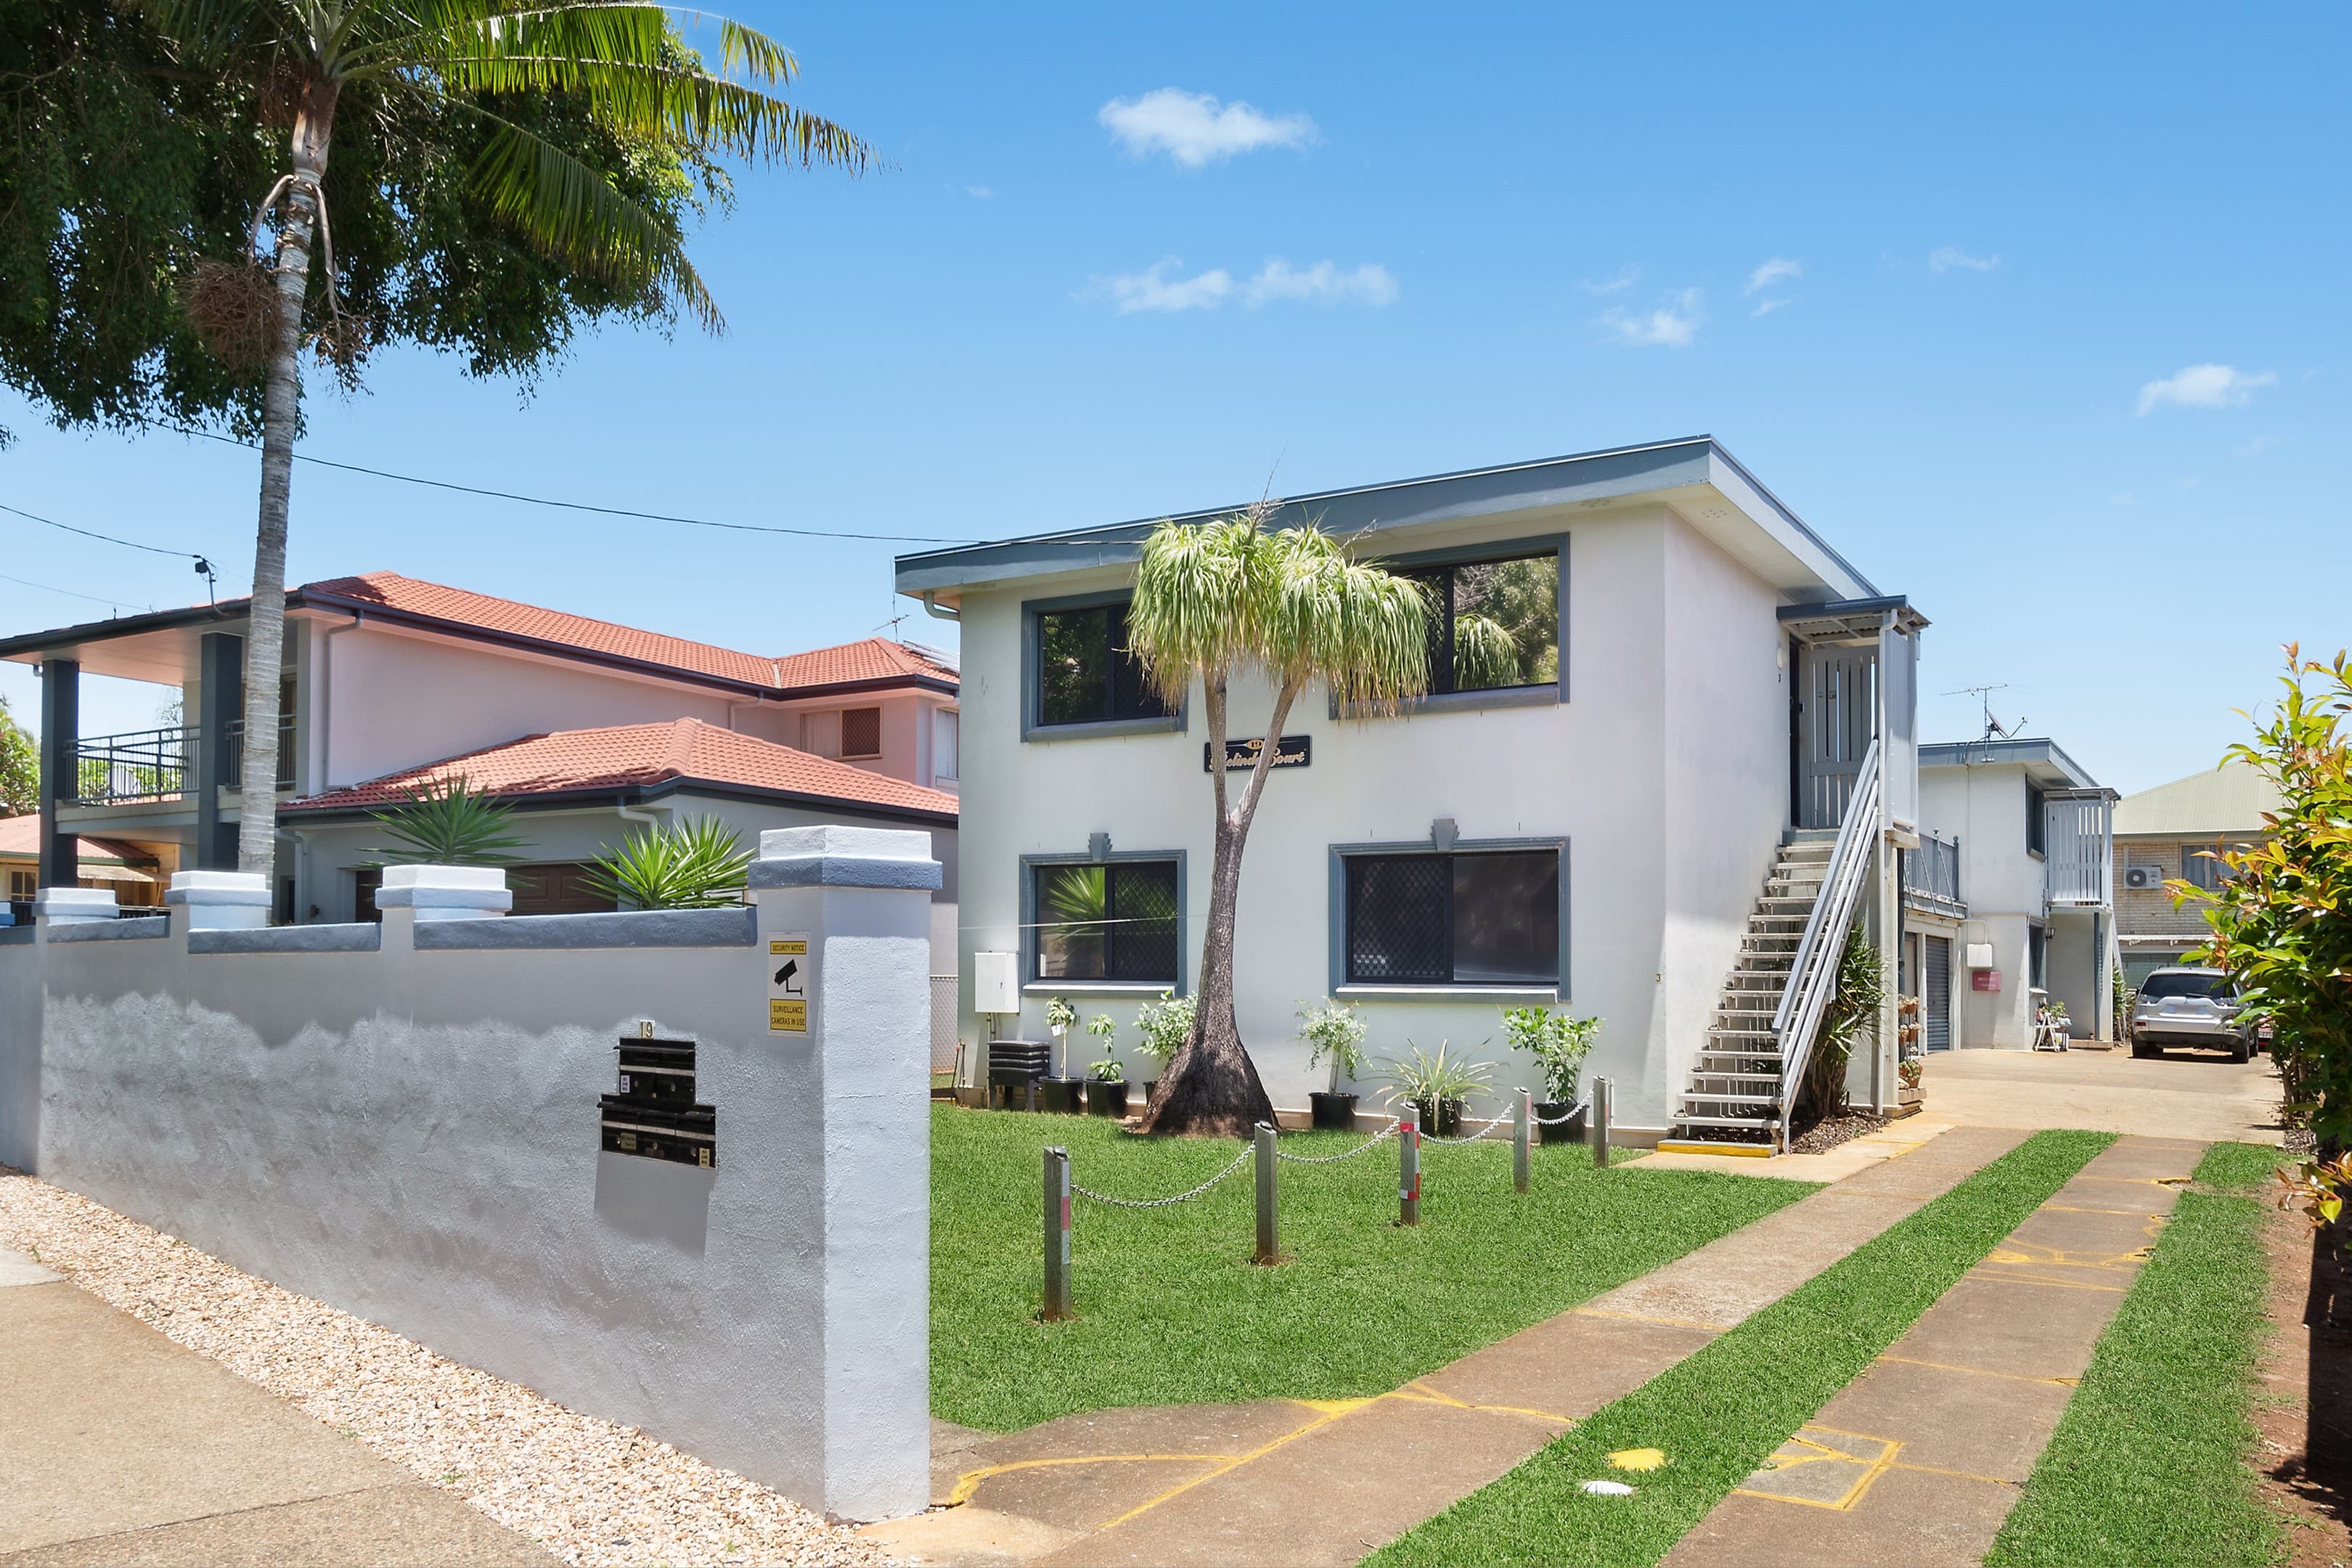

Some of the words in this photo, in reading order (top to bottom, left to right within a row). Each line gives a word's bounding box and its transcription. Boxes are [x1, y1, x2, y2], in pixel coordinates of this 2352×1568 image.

[1208, 750, 1259, 770] elind
[1656, 973, 1661, 982] 3
[773, 1005, 803, 1014] SURVEILLANCE
[640, 1021, 653, 1037] 19
